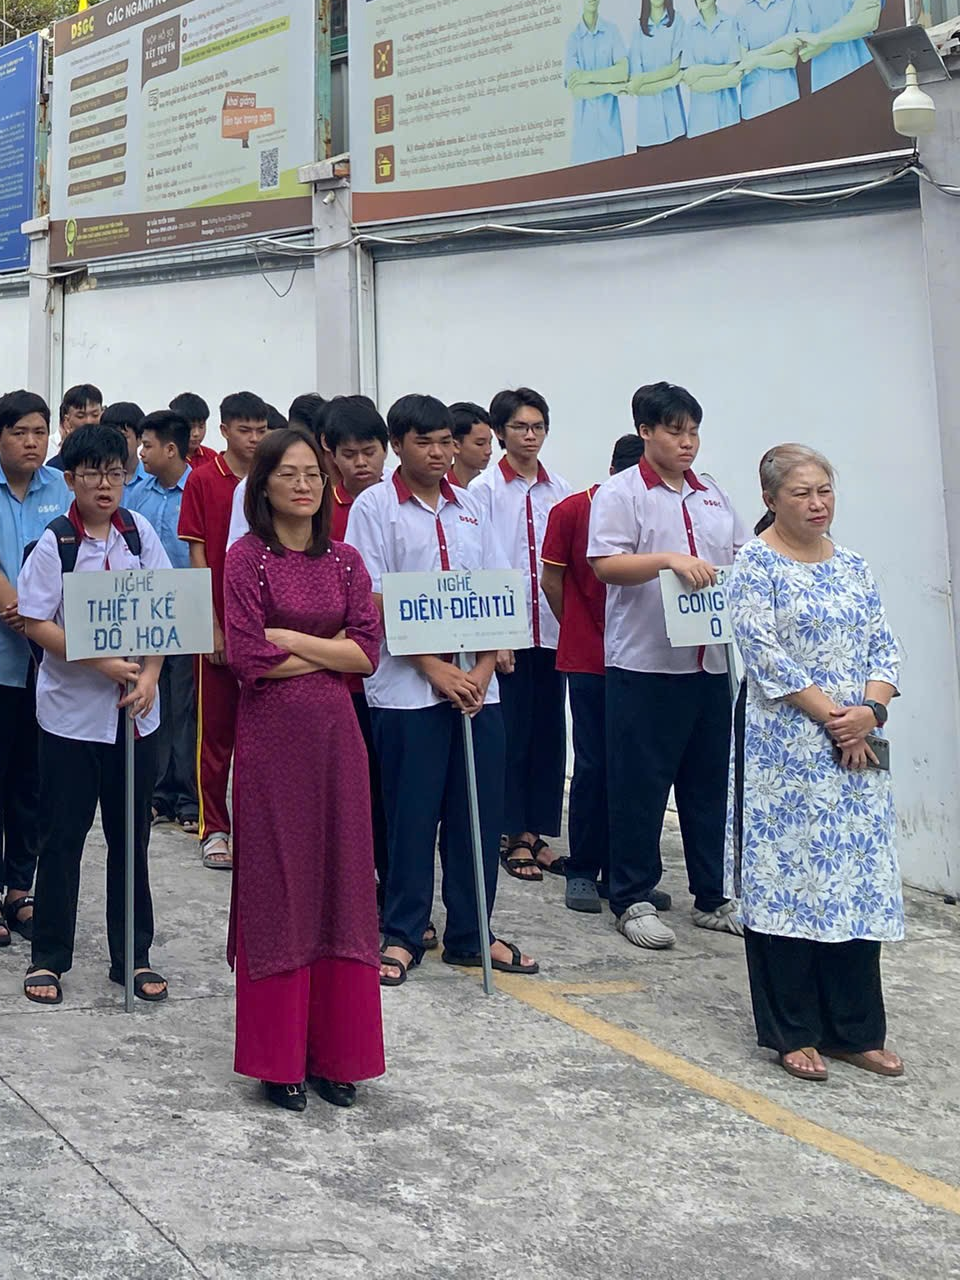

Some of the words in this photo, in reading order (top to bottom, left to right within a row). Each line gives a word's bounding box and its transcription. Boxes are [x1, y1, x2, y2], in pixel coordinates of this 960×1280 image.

[70, 16, 95, 40] DSGC
[106, 7, 124, 27] CÁC
[114, 570, 155, 593] NGHỀ
[437, 569, 473, 592] NGHỀ
[87, 591, 139, 623] THIẾT
[150, 590, 178, 620] KẾ
[492, 585, 515, 617] TỬ
[93, 621, 123, 651] ĐỒ
